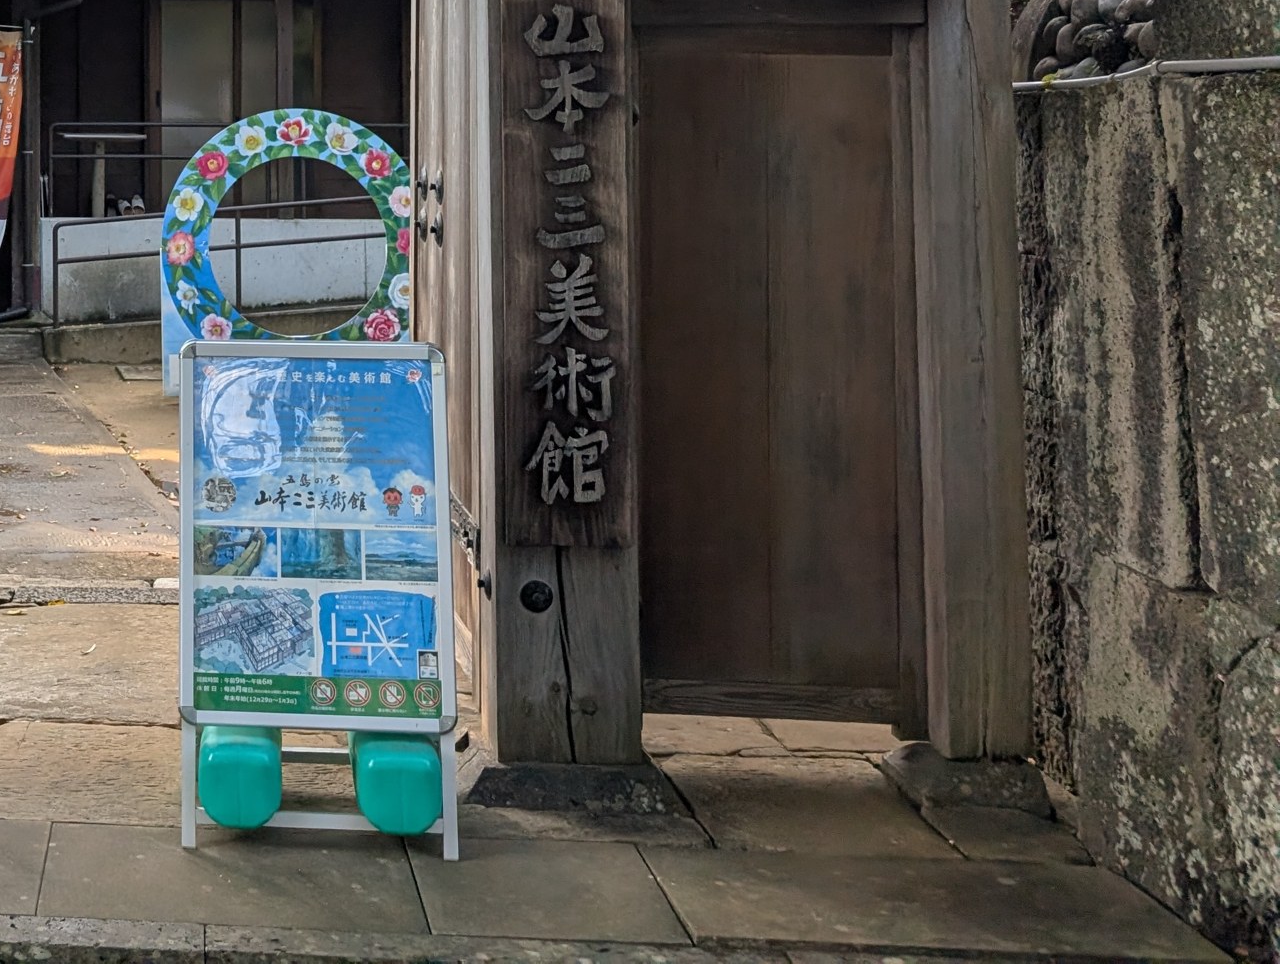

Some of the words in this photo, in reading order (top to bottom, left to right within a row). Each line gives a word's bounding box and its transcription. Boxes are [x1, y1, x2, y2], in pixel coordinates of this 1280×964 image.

[523, 3, 615, 506] 山本二三美術館
[254, 486, 368, 513] 山本二三美術館
